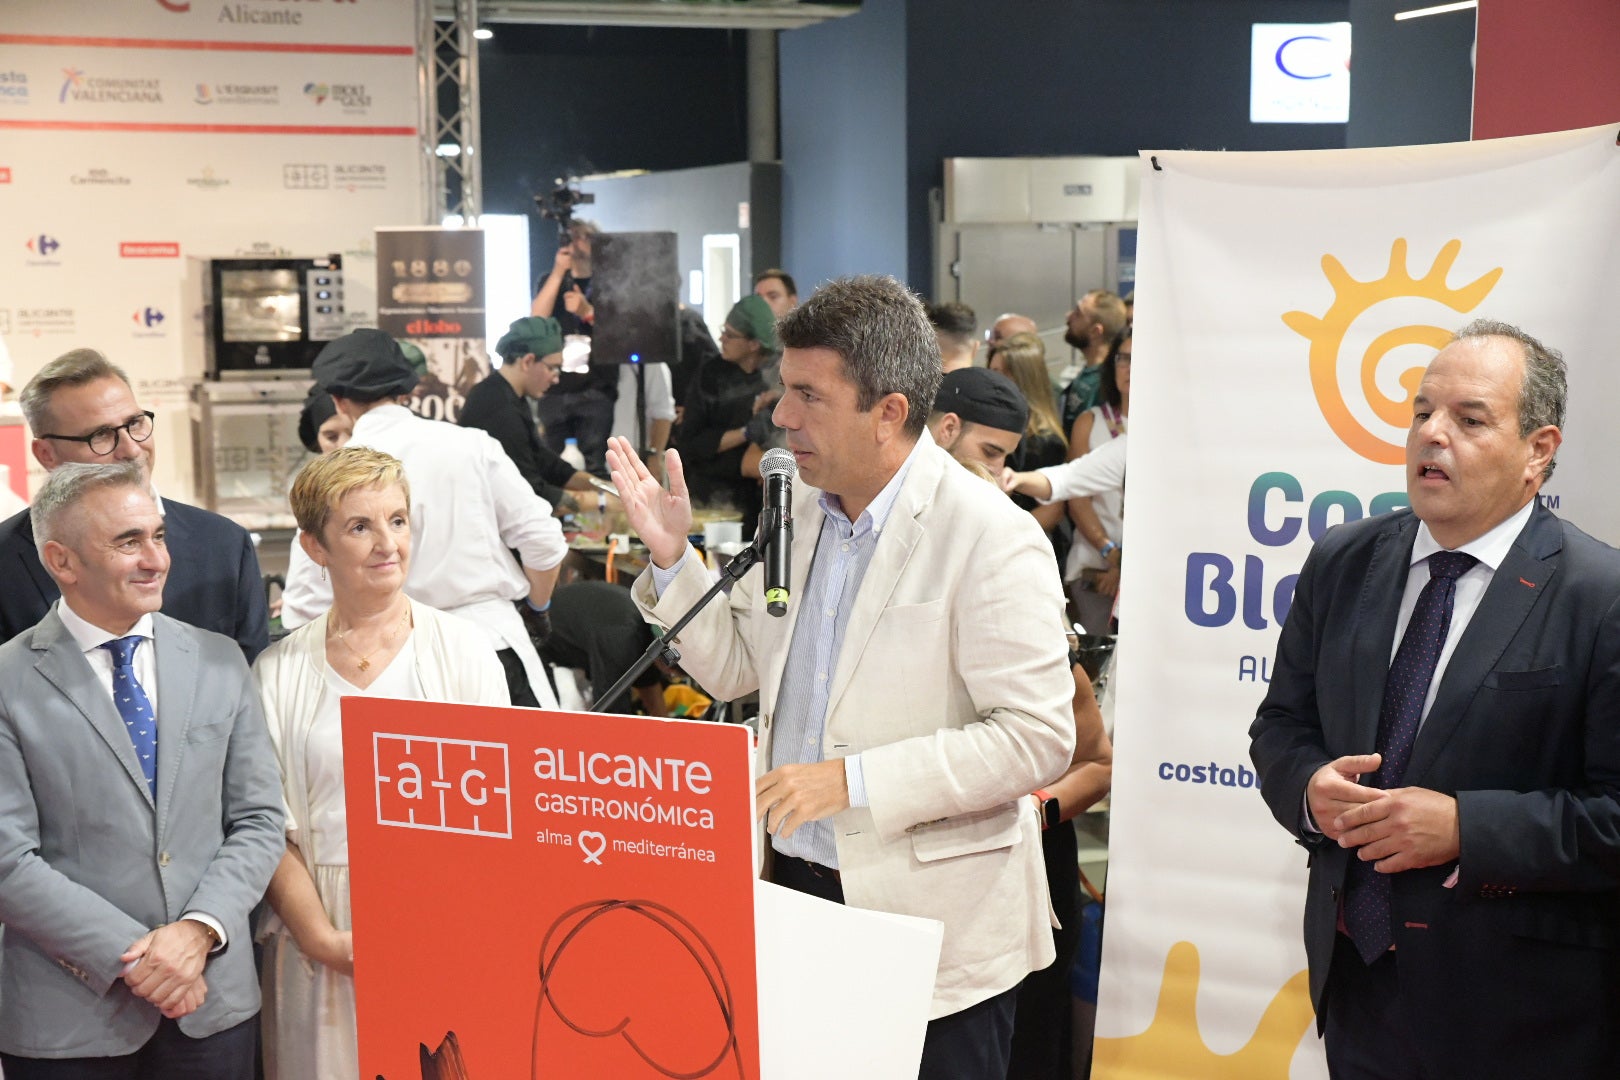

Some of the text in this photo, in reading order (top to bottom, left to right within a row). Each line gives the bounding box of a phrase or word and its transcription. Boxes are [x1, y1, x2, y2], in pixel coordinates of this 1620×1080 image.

[217, 4, 302, 25] Alicante
[71, 90, 163, 103] VALENCIANA
[535, 828, 716, 864] alma mediterránea
